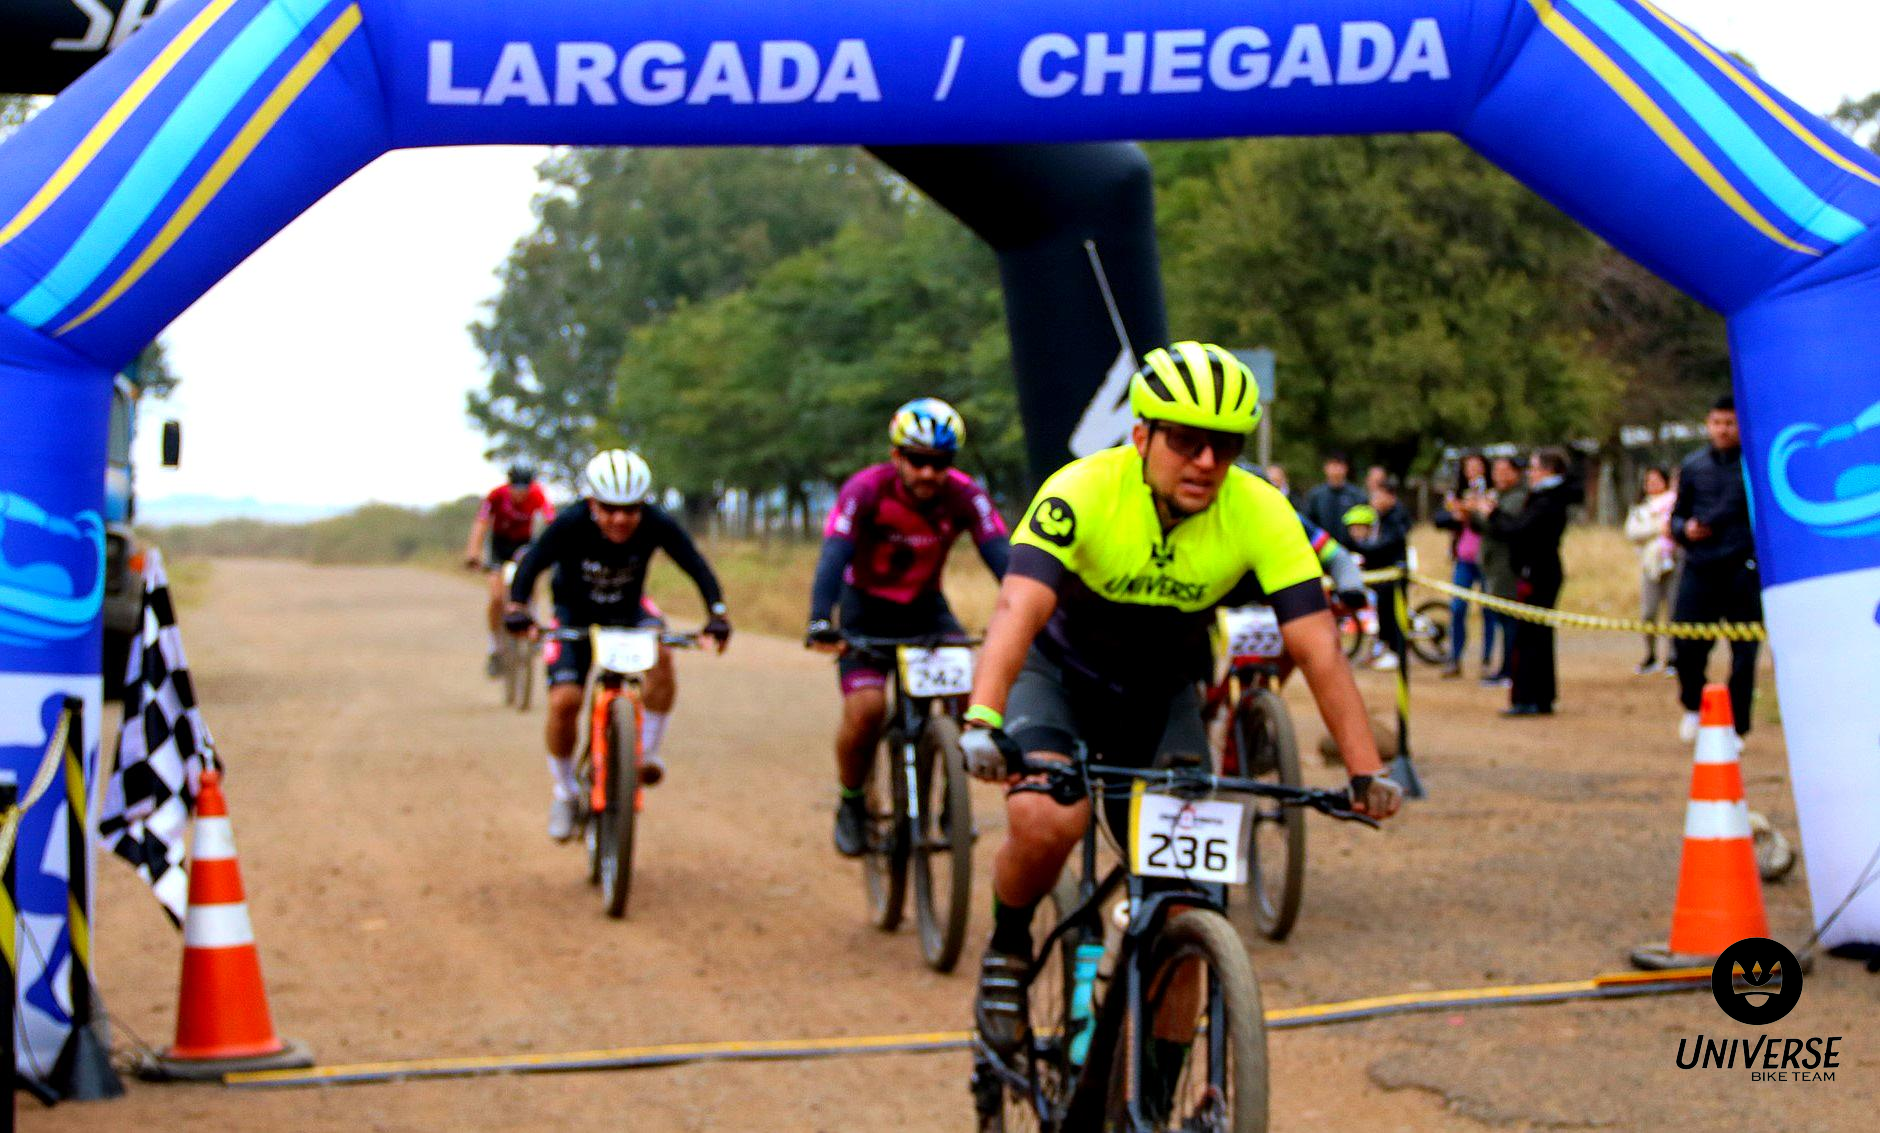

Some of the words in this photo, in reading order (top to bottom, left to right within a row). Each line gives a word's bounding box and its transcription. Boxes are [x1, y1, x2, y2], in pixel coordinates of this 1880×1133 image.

[427, 39, 882, 106] LARGADA
[933, 35, 965, 101] /
[1018, 17, 1450, 98] CHEGADA
[1103, 573, 1209, 603] UNIVERSE
[915, 667, 965, 690] 242
[1147, 833, 1228, 873] 236
